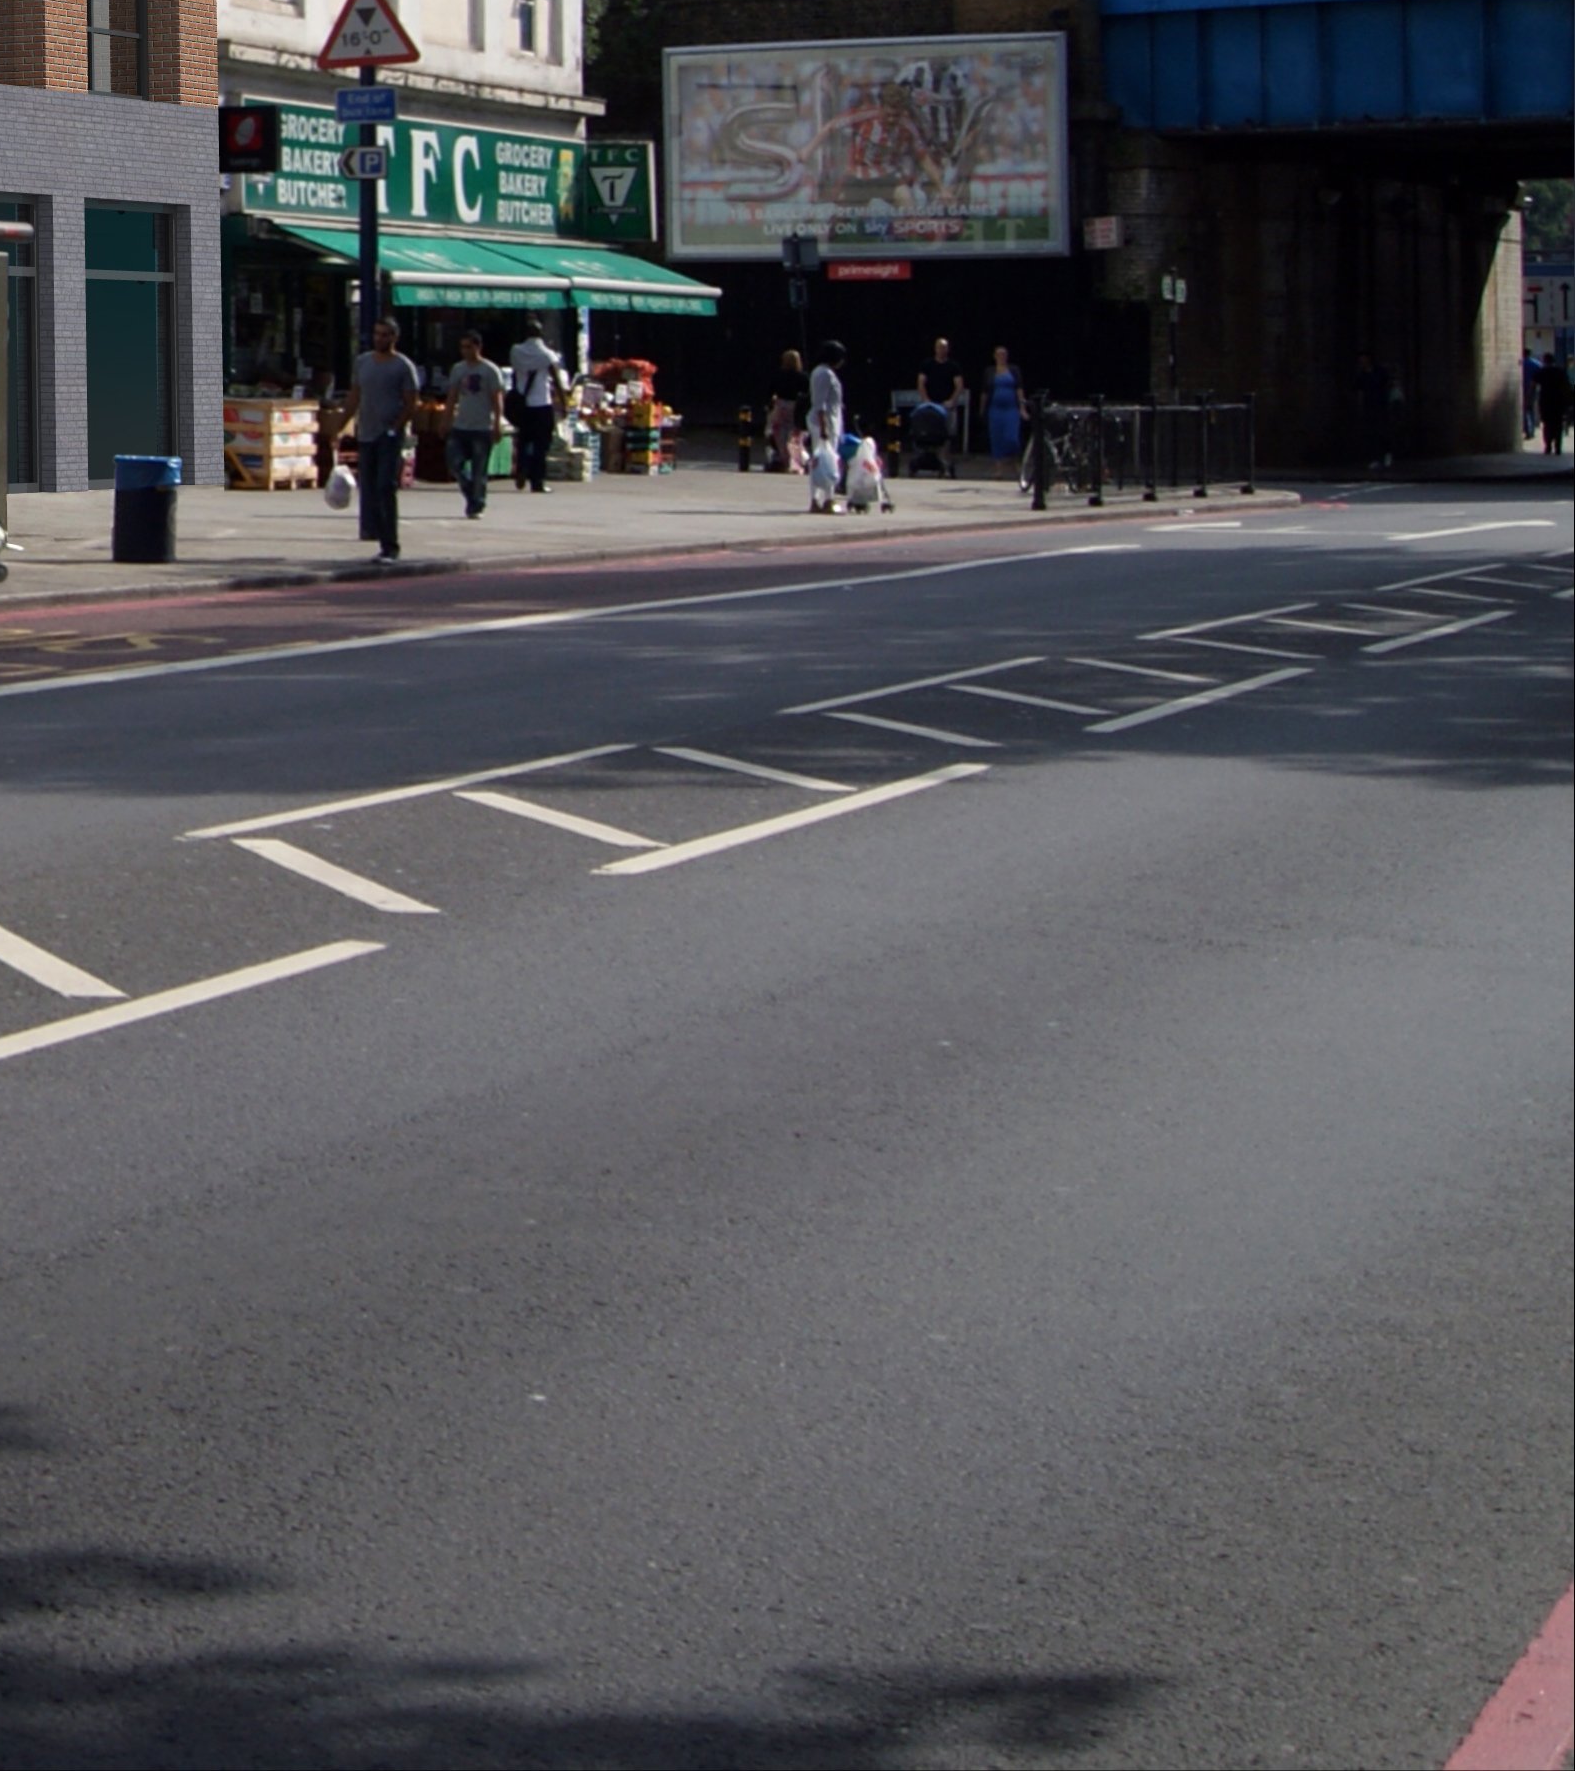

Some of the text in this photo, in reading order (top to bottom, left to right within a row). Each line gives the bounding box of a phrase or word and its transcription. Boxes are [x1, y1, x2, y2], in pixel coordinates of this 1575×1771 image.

[364, 153, 380, 173] P
[495, 141, 554, 170] GROCERY
[276, 179, 347, 209] BUTCHER
[498, 171, 548, 198] BAKERY
[496, 199, 554, 226] BUTCHER
[949, 204, 999, 217] GAMES
[763, 222, 793, 236] LIVE
[834, 222, 857, 235] ON
[893, 220, 961, 234] SPORTS
[837, 263, 900, 277] primesight
